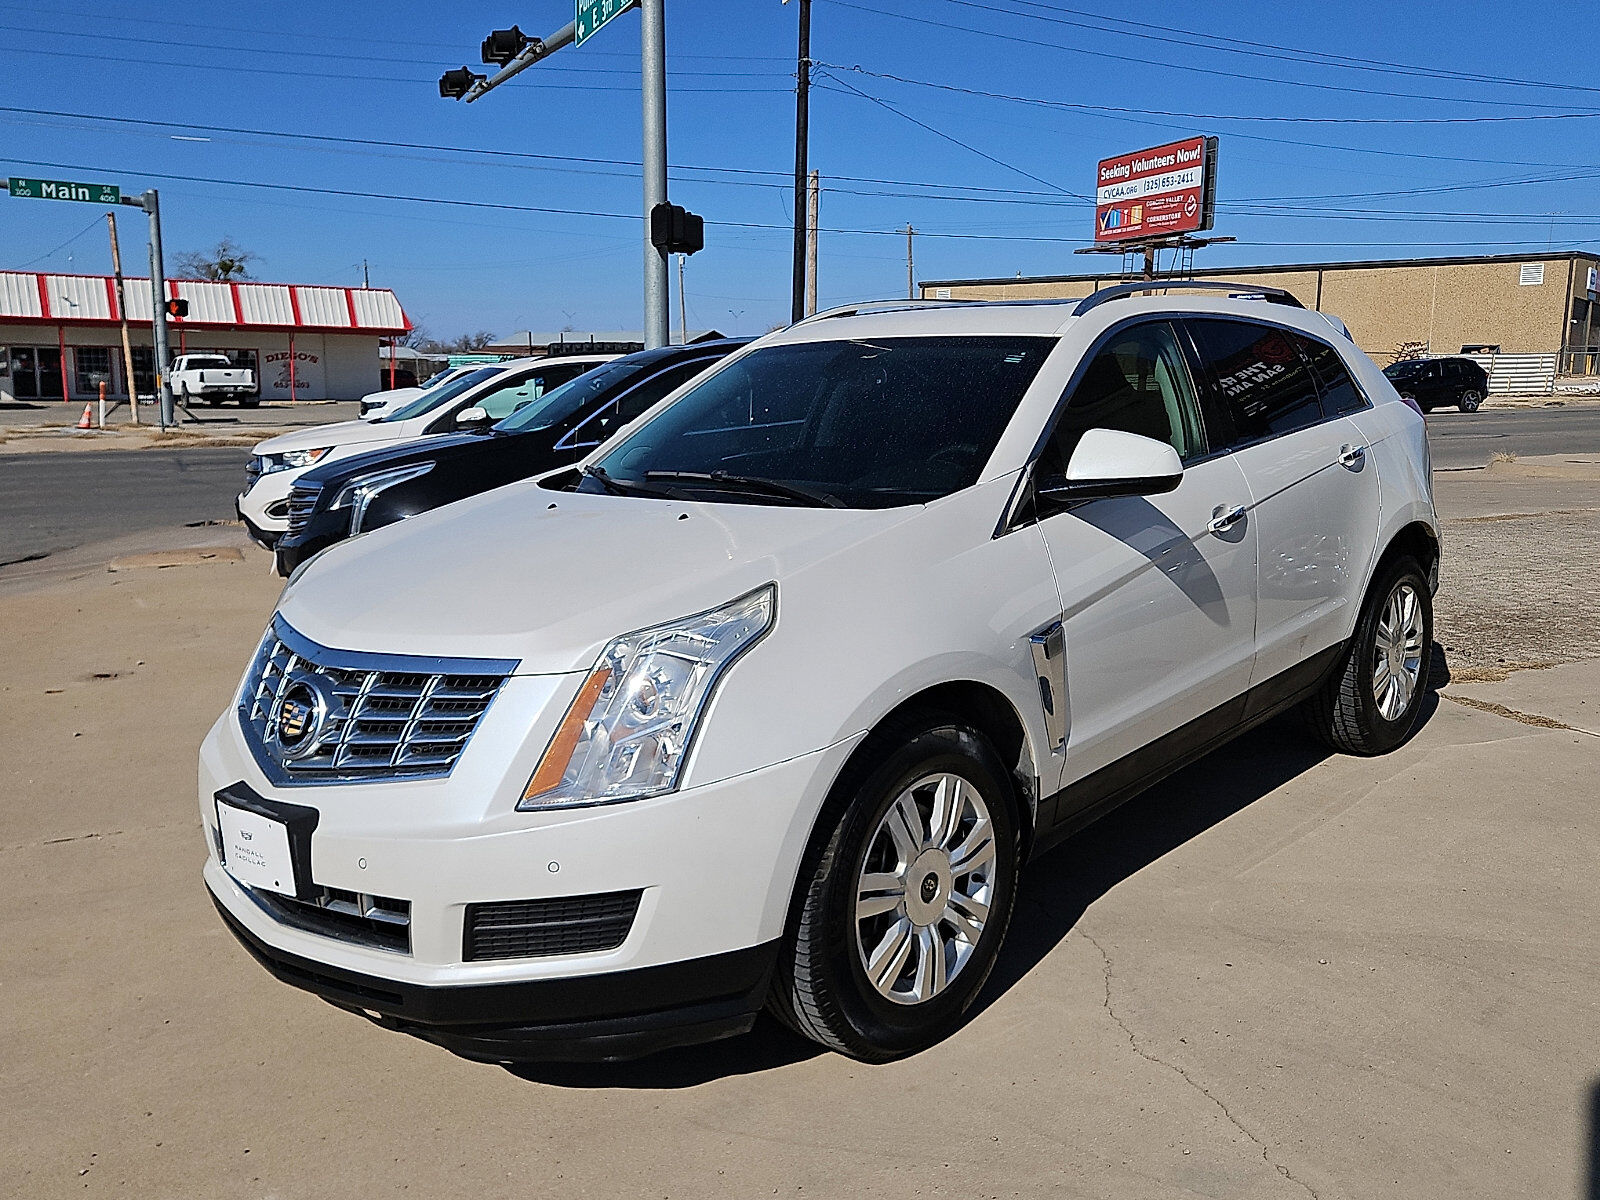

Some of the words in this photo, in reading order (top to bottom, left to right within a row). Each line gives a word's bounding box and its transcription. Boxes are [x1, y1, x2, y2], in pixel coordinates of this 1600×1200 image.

[593, 7, 599, 28] E
[1101, 163, 1130, 180] Seeking
[1131, 154, 1175, 173] Volunteers
[1177, 145, 1201, 163] Now!
[1143, 178, 1161, 192] (325)
[1161, 172, 1194, 187] 653-2411
[41, 183, 90, 200] Main
[234, 844, 264, 858] RANDALL
[235, 853, 266, 867] CADILLAC
